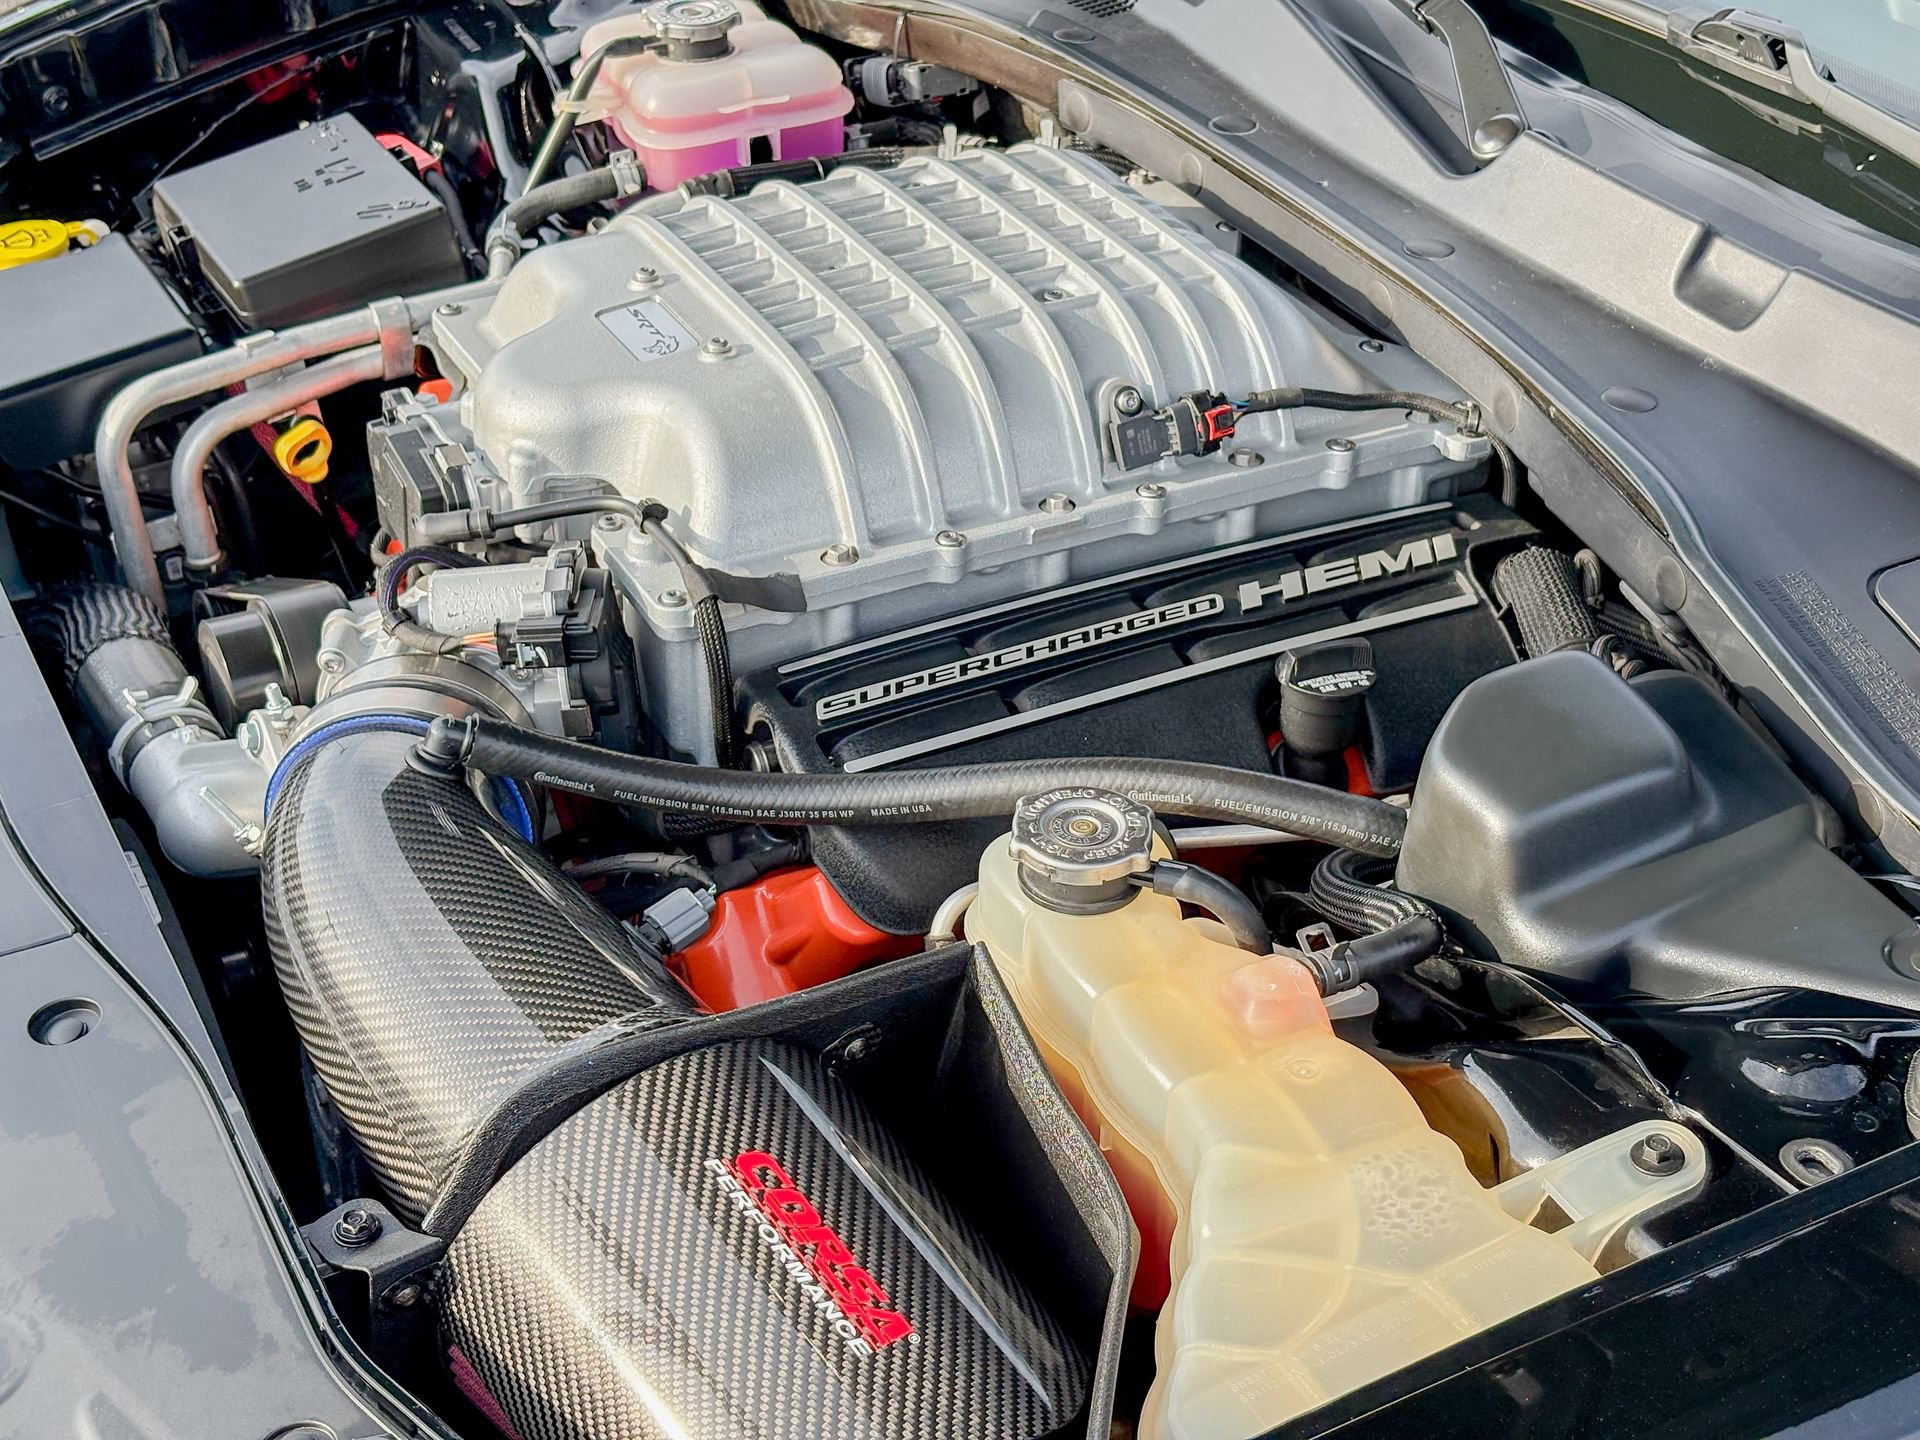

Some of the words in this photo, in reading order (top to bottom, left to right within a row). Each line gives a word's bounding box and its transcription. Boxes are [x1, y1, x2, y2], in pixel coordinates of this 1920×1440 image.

[626, 307, 665, 338] SRT
[820, 597, 1219, 718] SUPERCHARGED
[1239, 533, 1456, 614] HEMI
[1319, 684, 1338, 694] SAE
[533, 771, 589, 791] Continental
[613, 789, 689, 810] FUEL/EMISSION
[691, 803, 709, 812] 5/8"
[711, 805, 754, 817] (15.9mm)
[756, 808, 776, 818] SAE
[778, 809, 806, 819] J30R7
[808, 810, 820, 819] 35
[822, 810, 838, 818] PSI
[839, 810, 855, 818] WP
[1099, 793, 1133, 812] NOT
[1127, 789, 1184, 805] Continental
[870, 807, 899, 817] MADE
[900, 805, 910, 815] IN
[912, 804, 933, 814] USA
[1214, 798, 1299, 822] FUEL/EMISSION
[1300, 814, 1322, 826] 5/8"
[1322, 819, 1370, 842] (15.9mm)
[1369, 833, 1391, 847] SAE
[1083, 839, 1129, 860] KEEP
[703, 1158, 873, 1357] PERFORMANCE
[736, 1150, 914, 1348] CORSA
